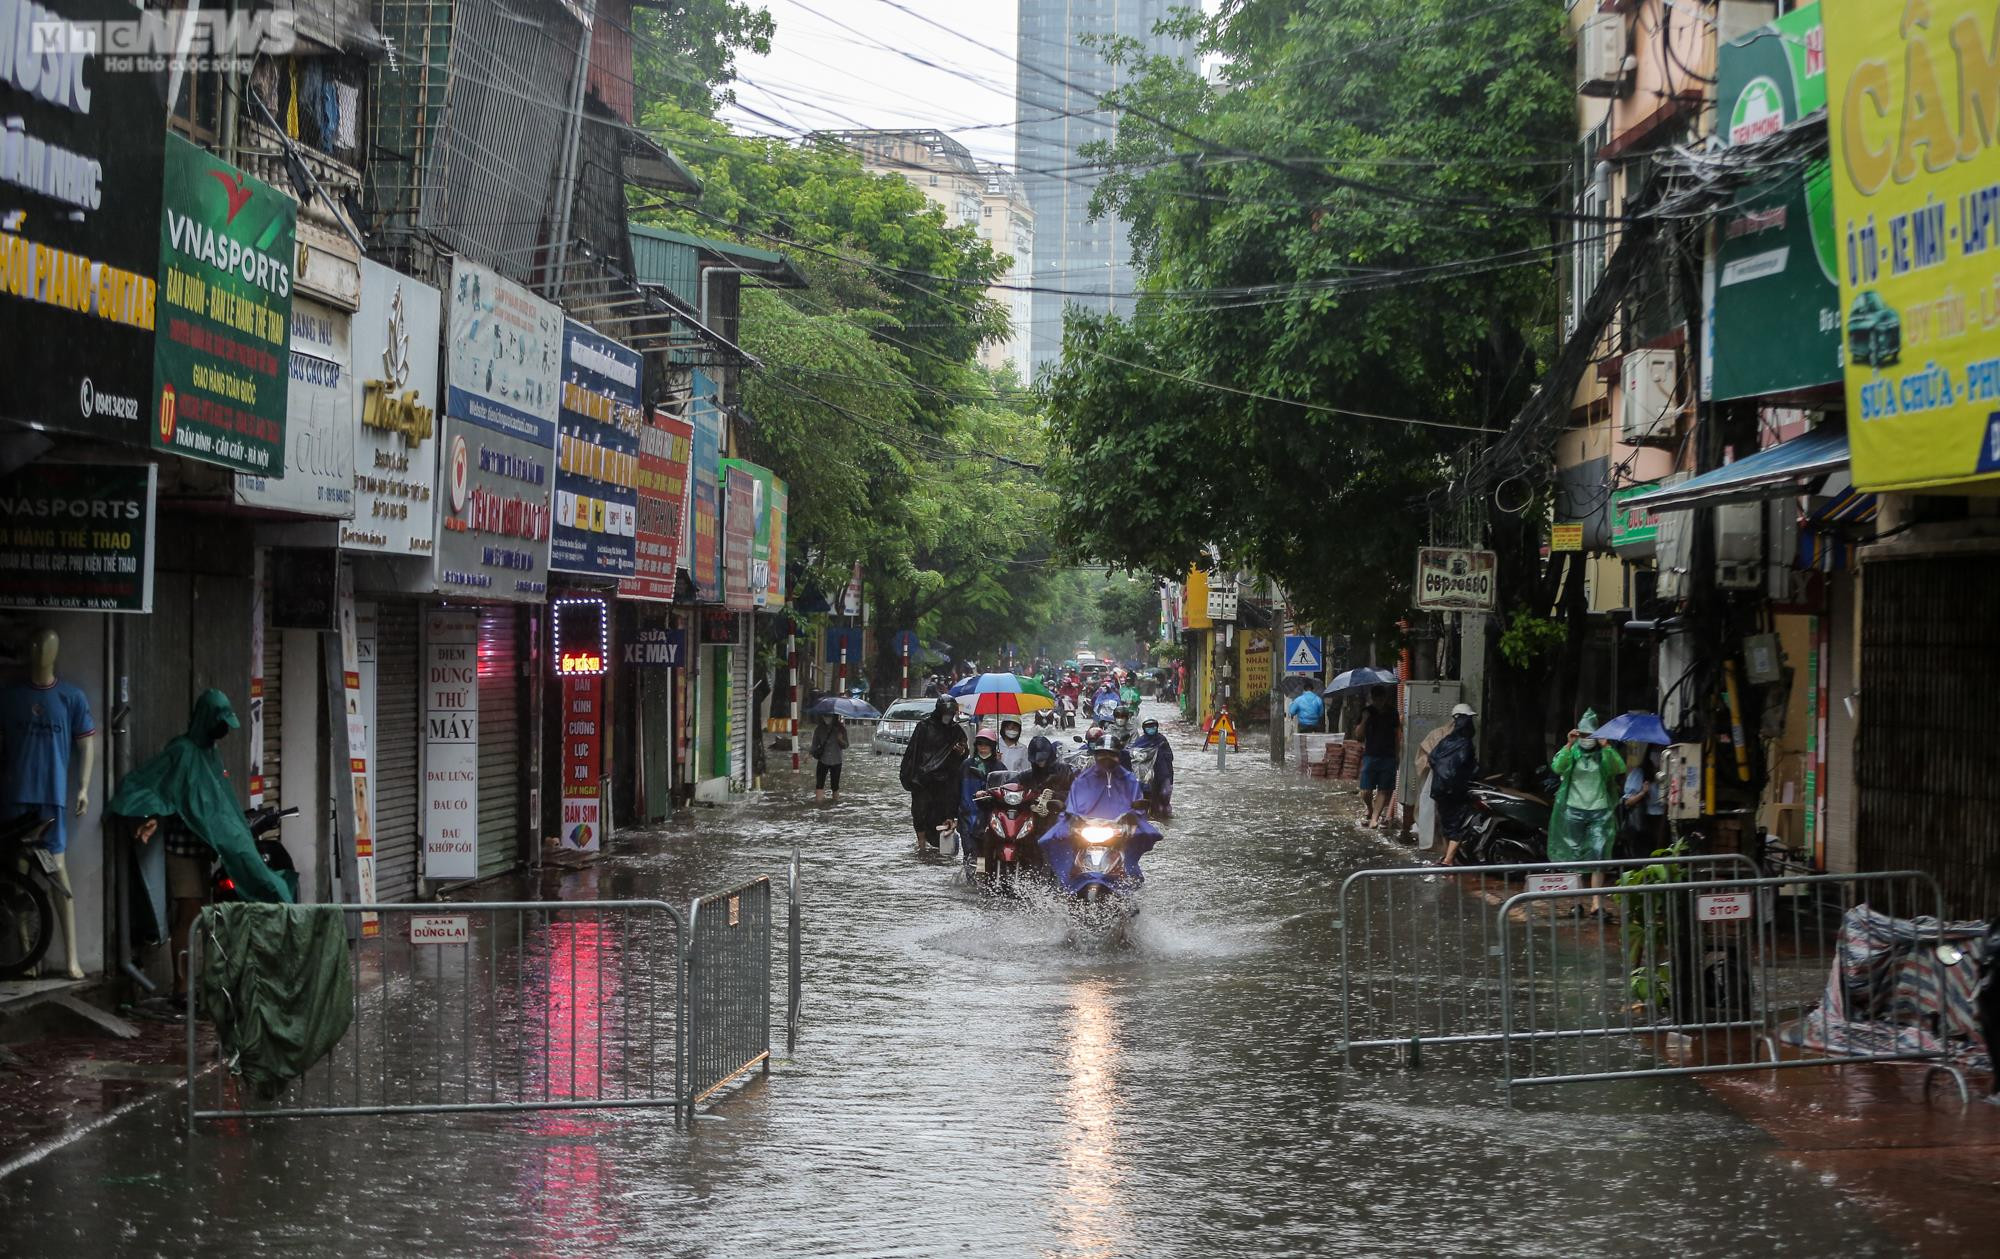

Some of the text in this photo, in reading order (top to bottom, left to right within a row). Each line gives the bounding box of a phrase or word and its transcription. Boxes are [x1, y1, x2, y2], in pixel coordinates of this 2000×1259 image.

[1912, 192, 1946, 269] MÁY
[167, 208, 289, 298] VNASPORTS
[161, 390, 176, 436] 07
[92, 531, 131, 549] THAO
[624, 643, 643, 663] XE
[431, 661, 473, 683] DÙNG
[435, 687, 469, 708] THỬ
[429, 713, 474, 739] MÁY
[574, 743, 588, 760] LỰC
[427, 770, 474, 782] ĐAU LƯNG
[574, 765, 588, 782] XỊN
[433, 800, 452, 811] ĐAU
[565, 802, 597, 823] BÁN SIM
[442, 828, 461, 839] ĐAU
[1709, 905, 1741, 916] STOP
[414, 926, 445, 937] DỪNG
